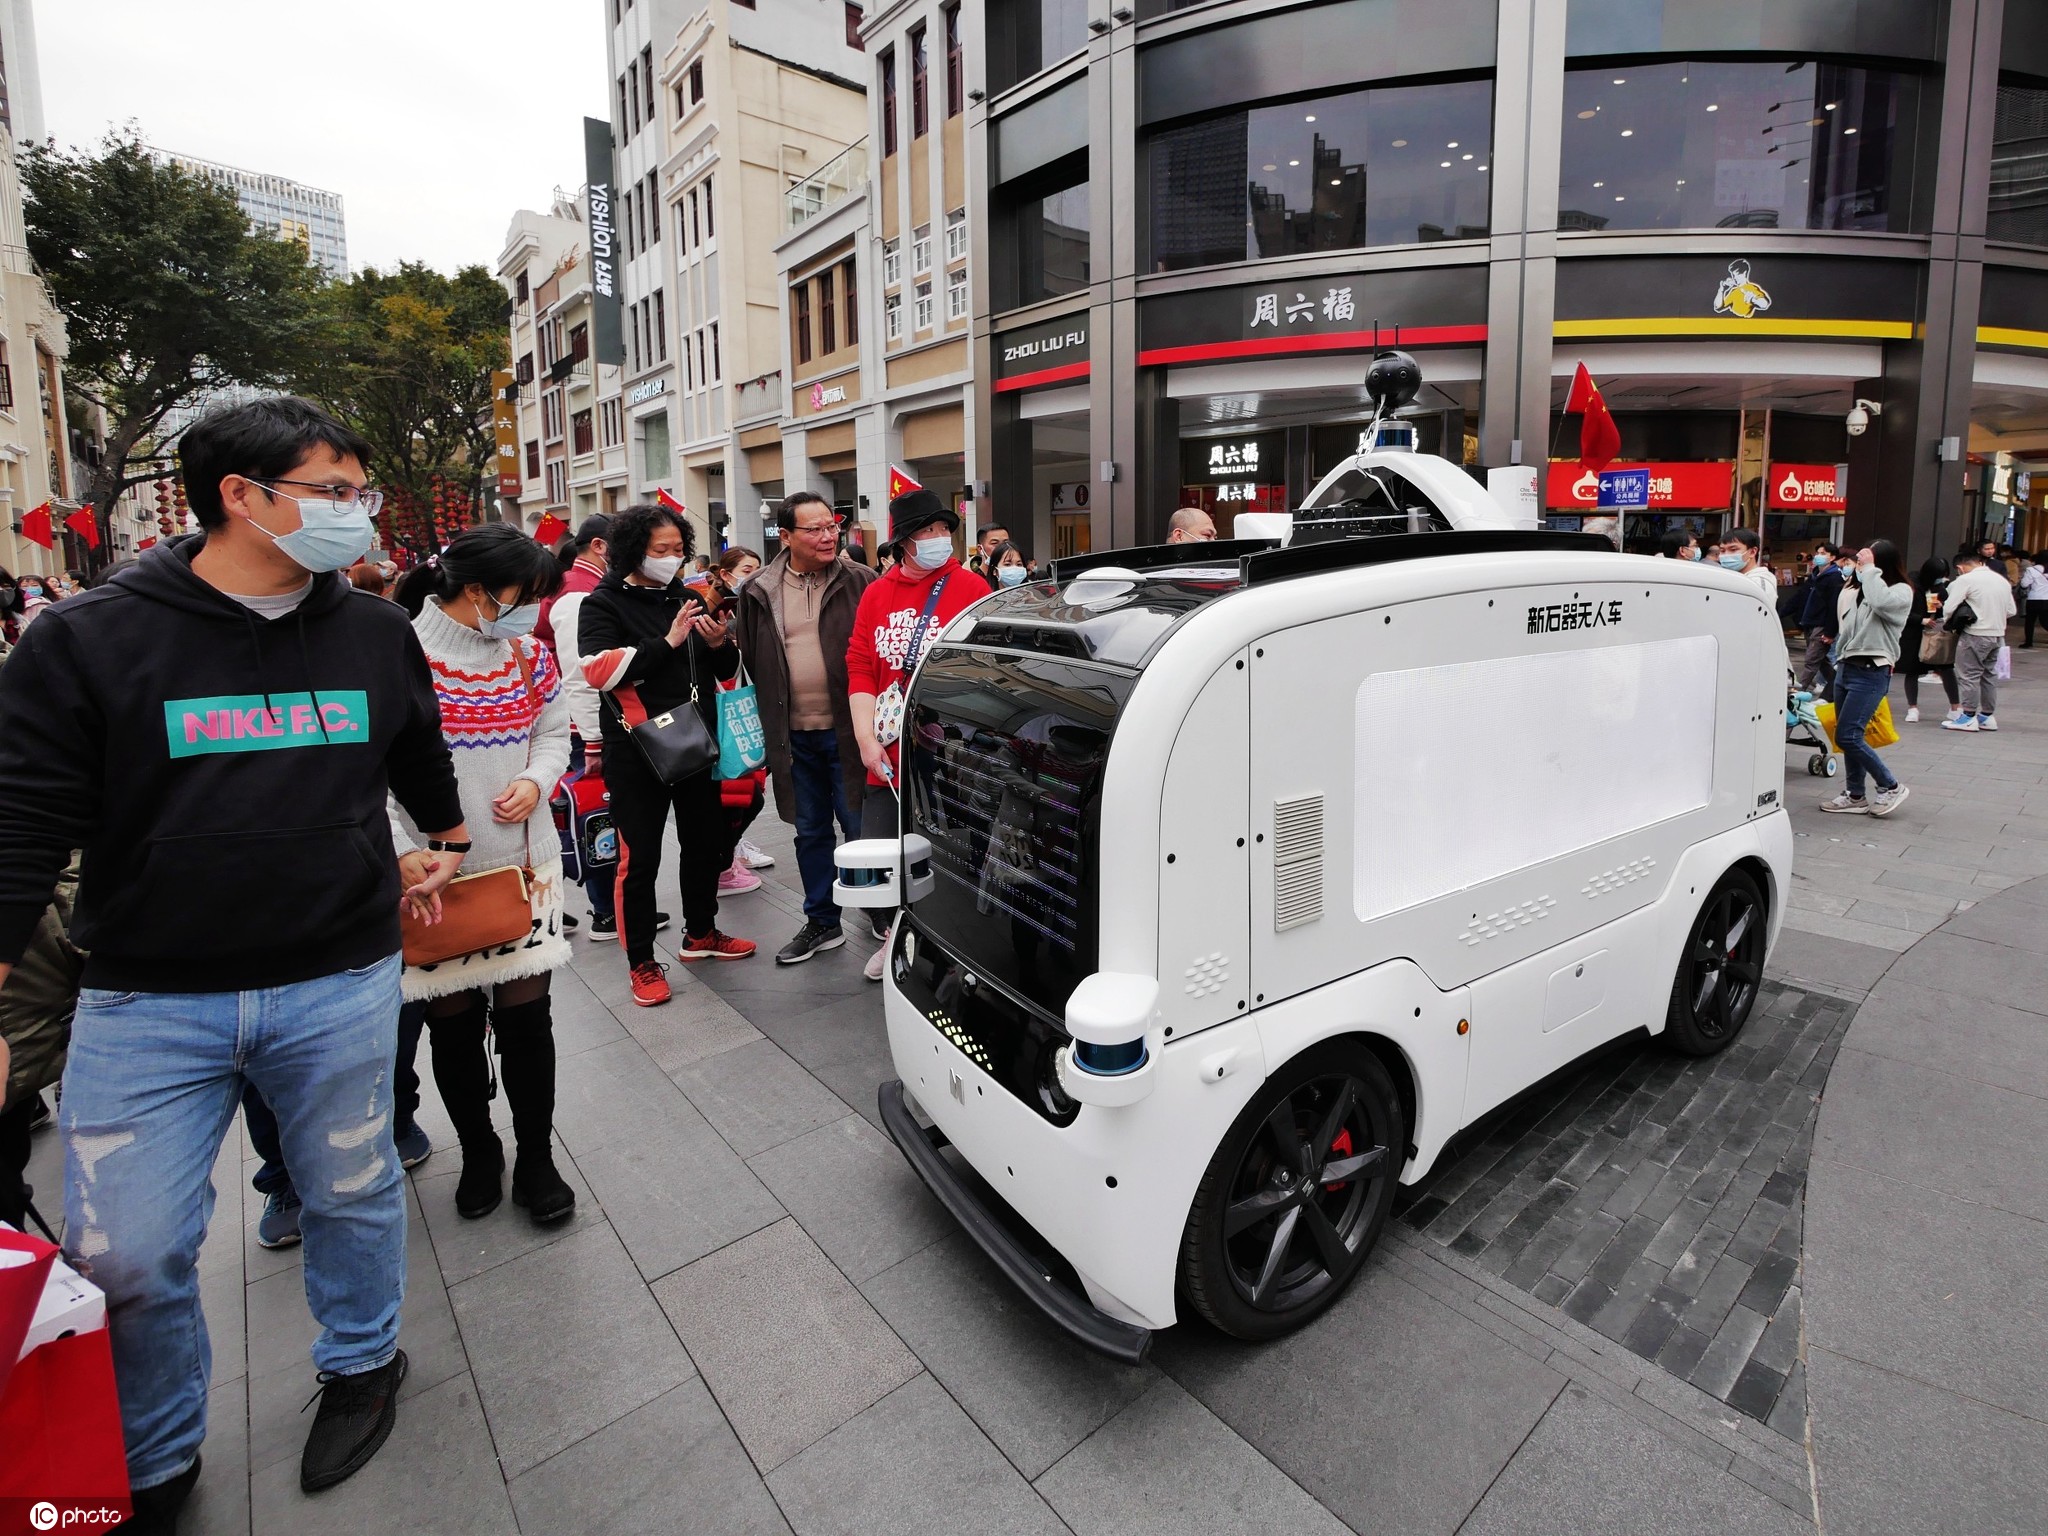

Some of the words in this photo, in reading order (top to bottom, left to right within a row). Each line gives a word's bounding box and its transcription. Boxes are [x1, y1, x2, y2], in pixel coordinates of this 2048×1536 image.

[1250, 286, 1356, 328] 周六福
[1004, 341, 1039, 362] ZHOU
[1041, 335, 1063, 353] LIU
[1066, 330, 1085, 347] FU
[1208, 442, 1259, 466] 周六福
[1209, 466, 1232, 475] ZHOU
[1232, 465, 1245, 473] LIU
[1245, 464, 1258, 472] FU
[1216, 482, 1257, 502] 周六福
[1527, 600, 1623, 635] 新石器无人车
[182, 706, 284, 744] NIKE
[289, 702, 359, 736] F.C.
[728, 713, 762, 737] 你的
